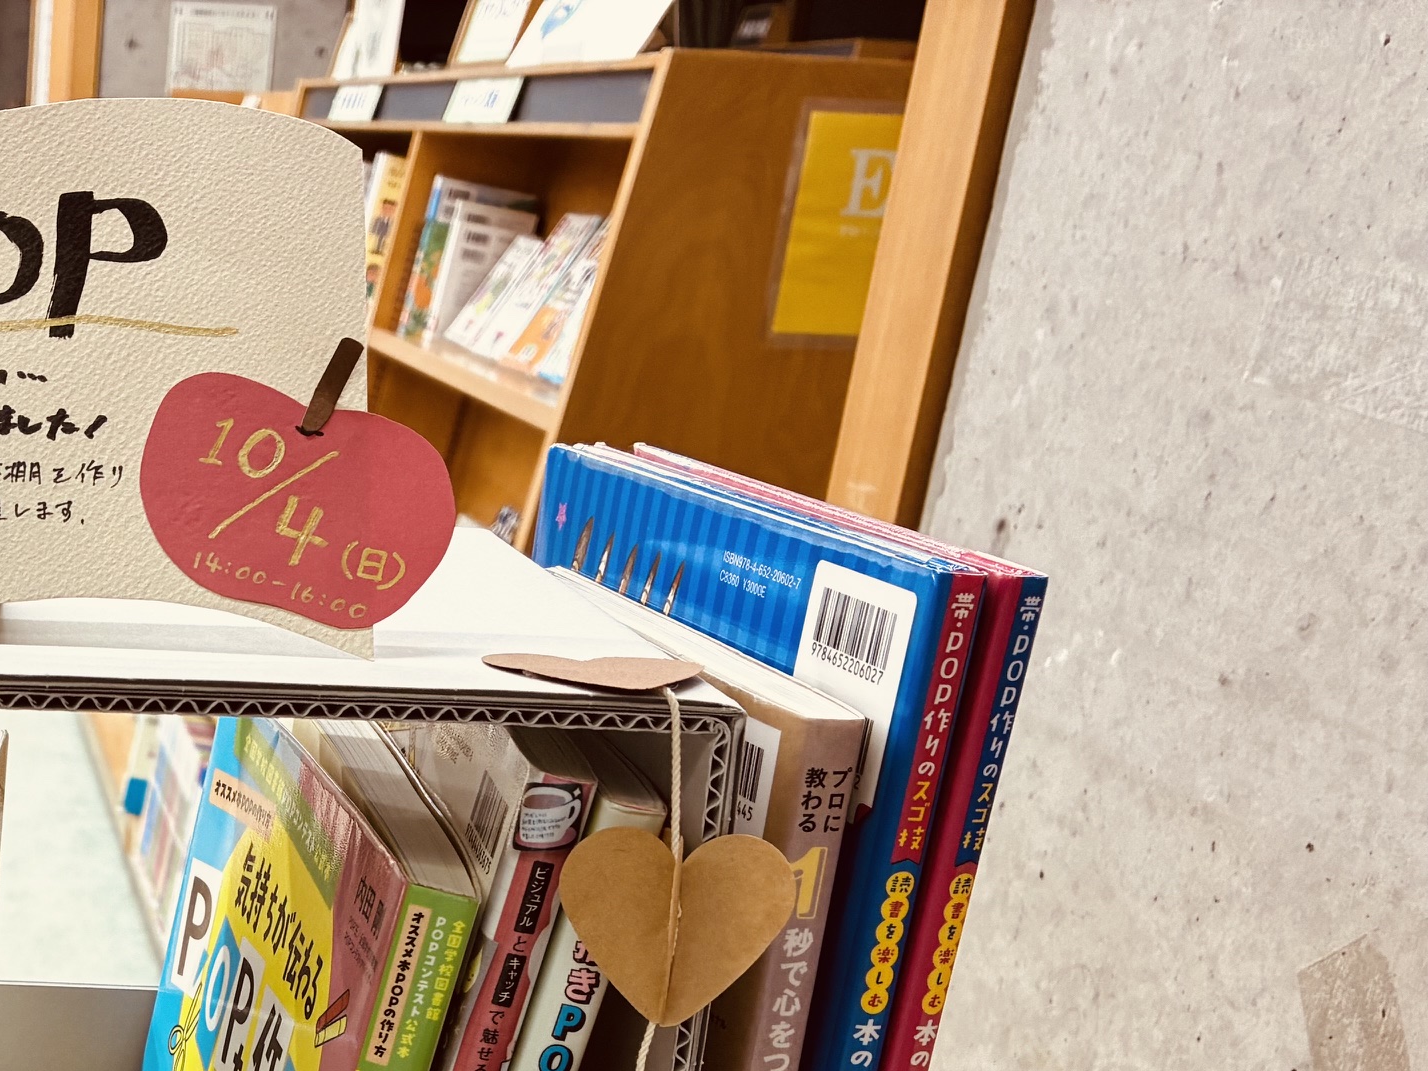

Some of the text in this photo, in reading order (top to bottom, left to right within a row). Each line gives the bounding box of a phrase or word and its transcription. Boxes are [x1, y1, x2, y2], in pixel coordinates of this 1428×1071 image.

[812, 642, 883, 685] 9784652206027
[798, 767, 826, 832] 教わる
[823, 767, 853, 832] プロに
[235, 841, 324, 1021] 気持ちが伝わる
[374, 912, 424, 1058] オススメ本POPの作り方
